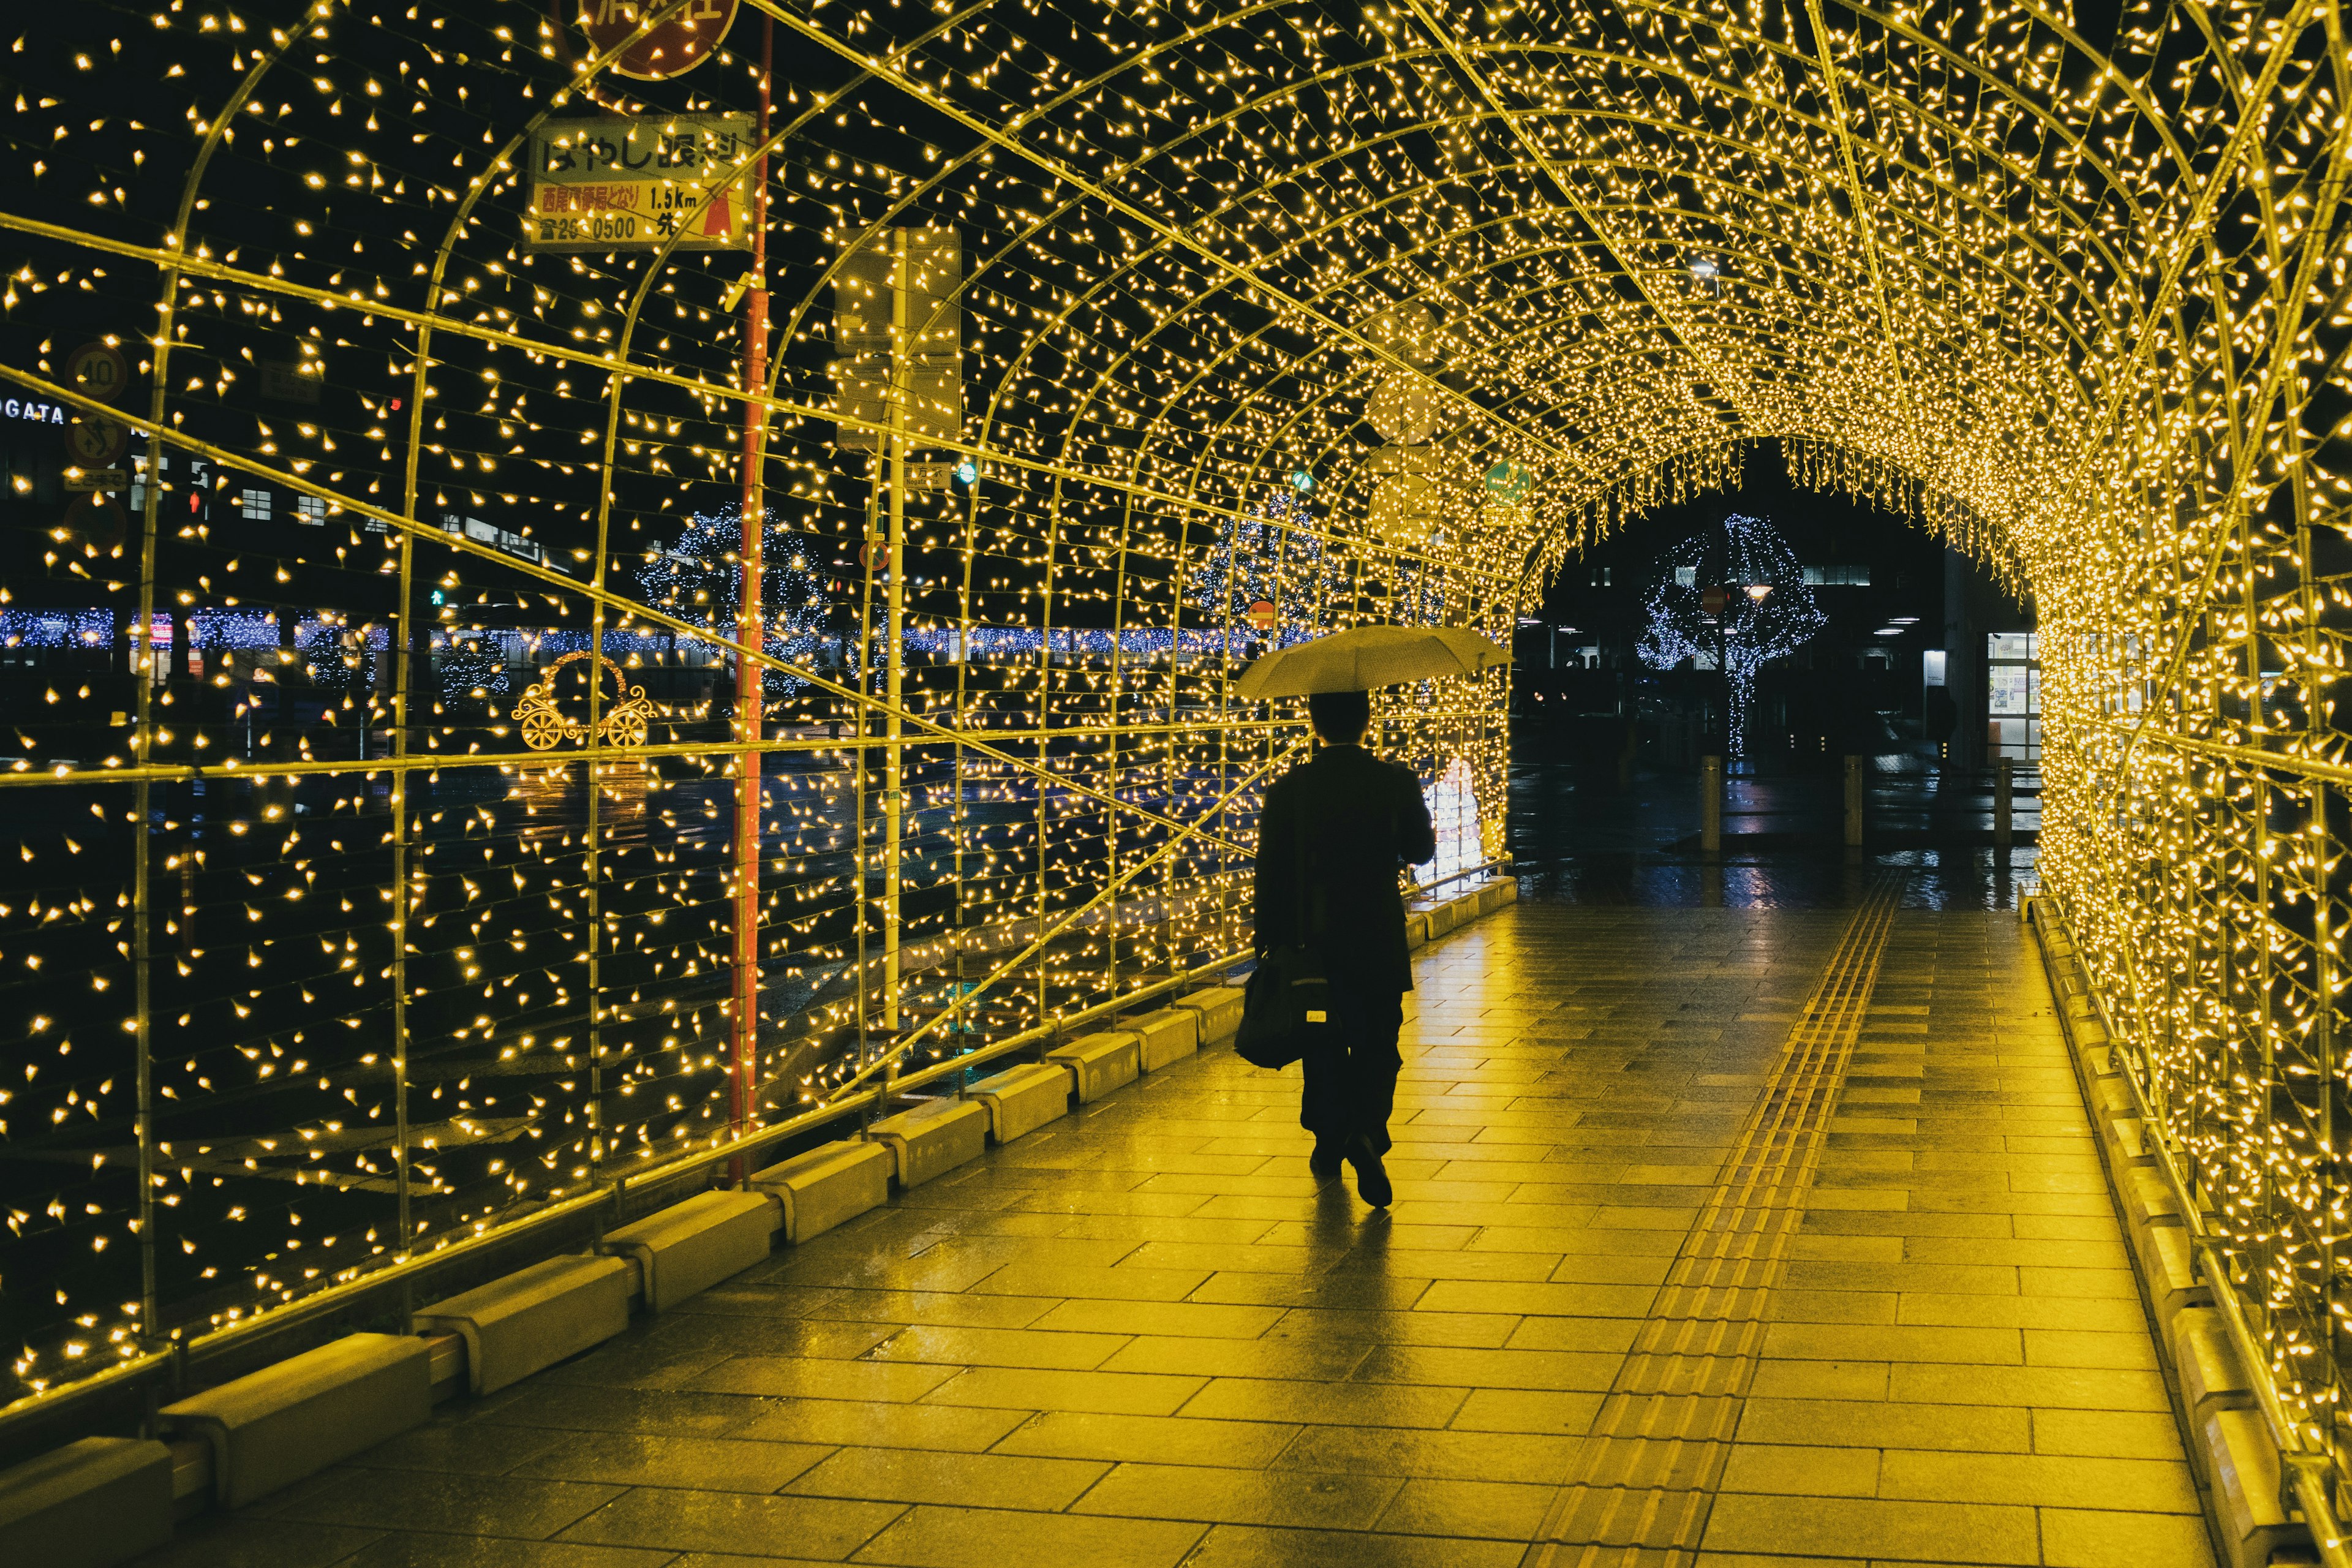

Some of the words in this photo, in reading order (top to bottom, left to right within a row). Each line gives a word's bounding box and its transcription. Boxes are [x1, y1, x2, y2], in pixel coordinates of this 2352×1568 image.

[543, 132, 737, 172] はやし眼科
[651, 186, 697, 209] 1.5km
[593, 216, 636, 239] 0500
[80, 359, 112, 386] 40
[0, 399, 64, 425] GATA
